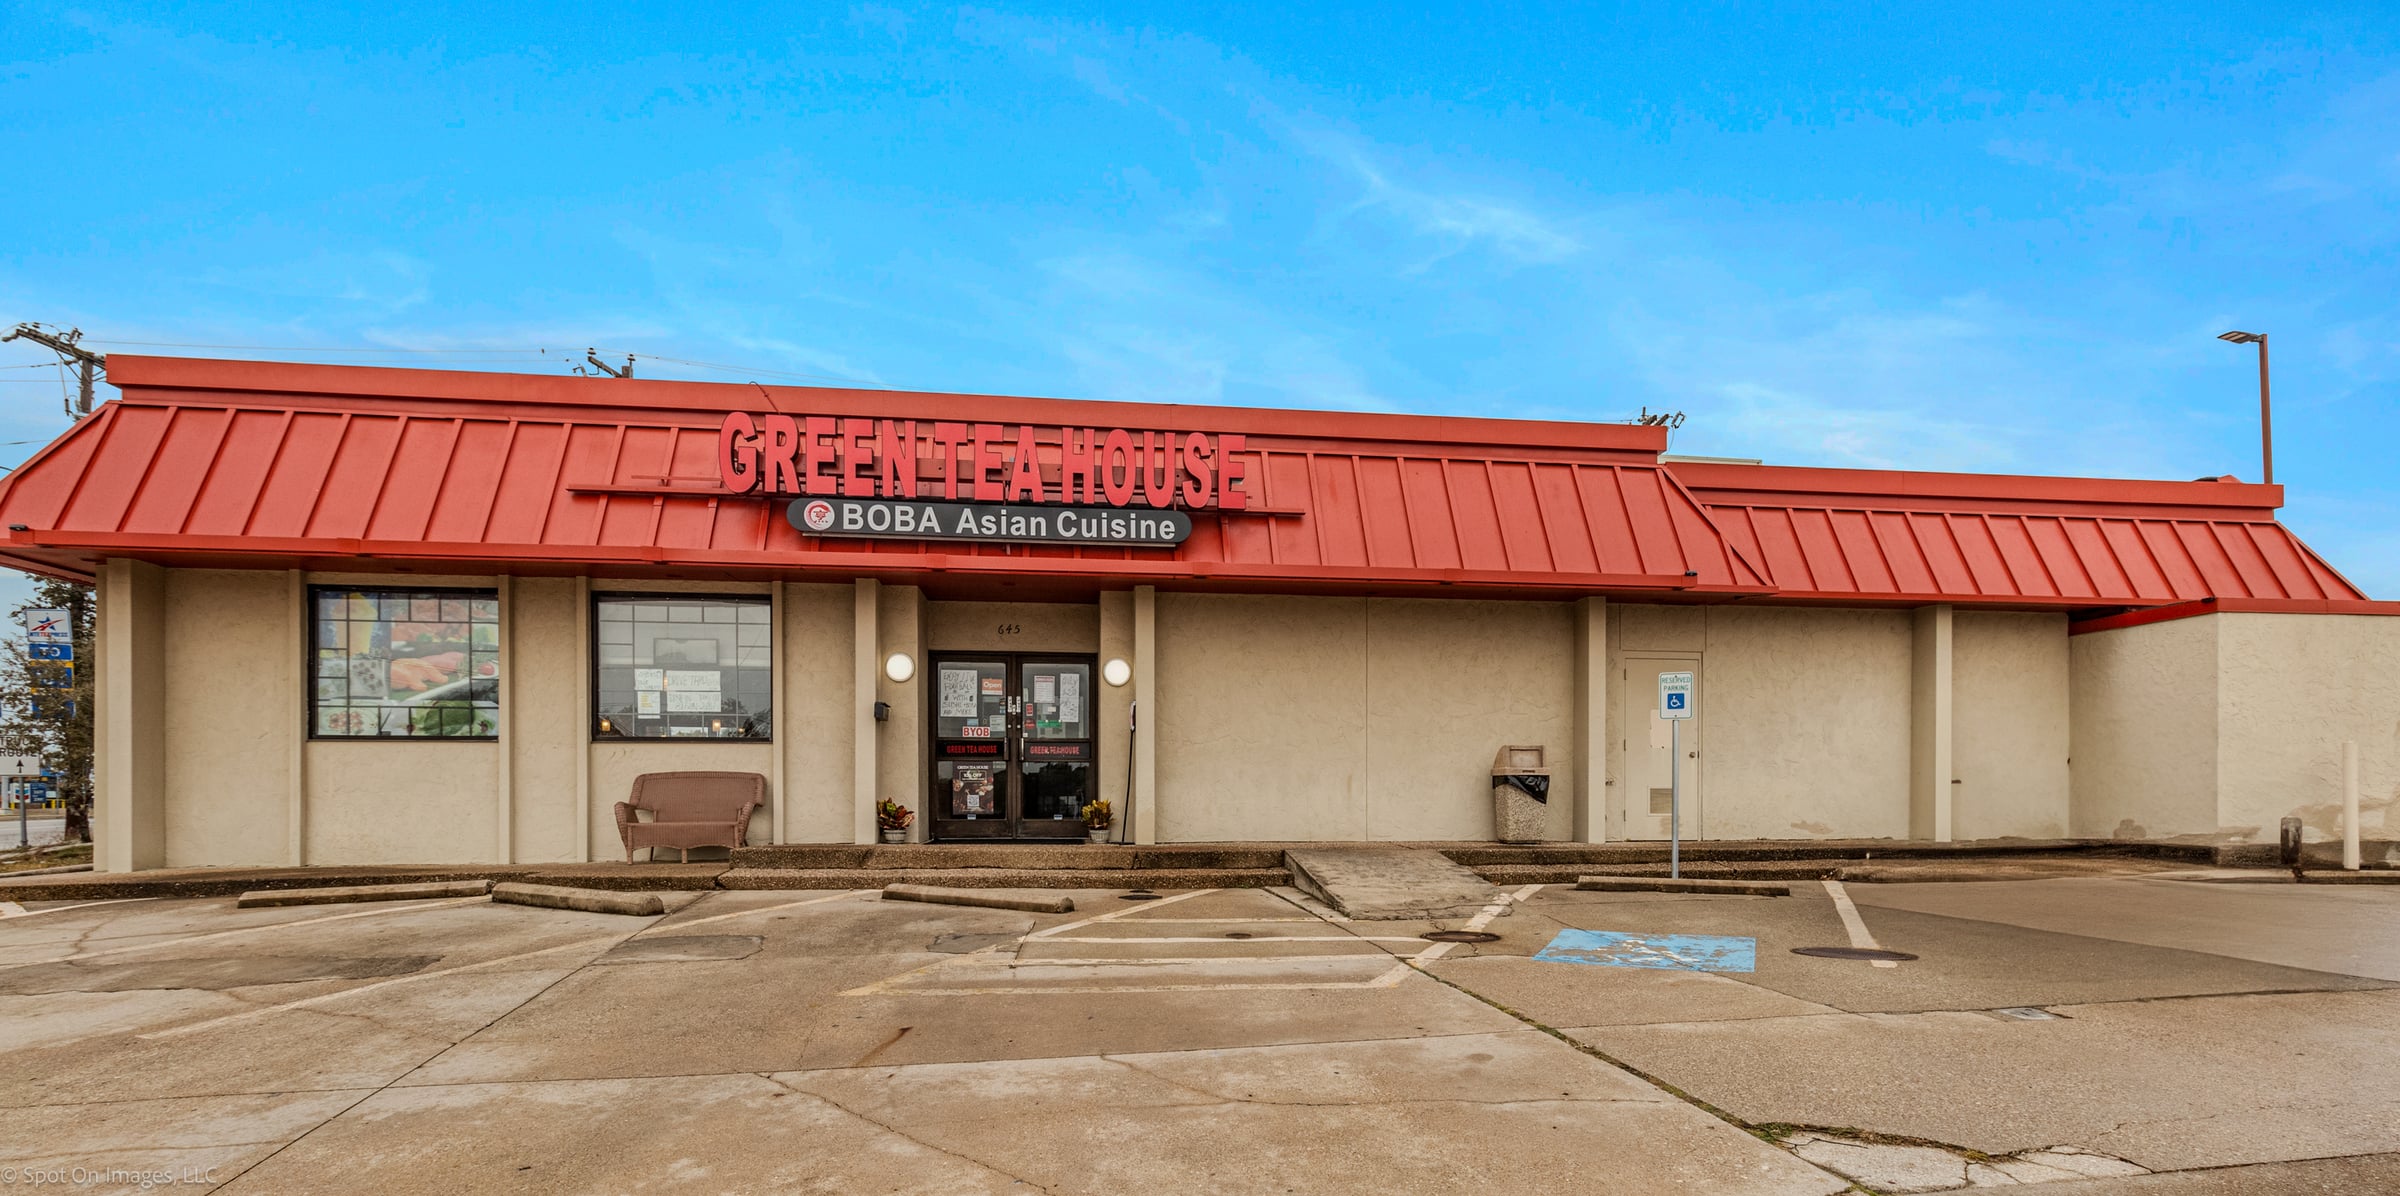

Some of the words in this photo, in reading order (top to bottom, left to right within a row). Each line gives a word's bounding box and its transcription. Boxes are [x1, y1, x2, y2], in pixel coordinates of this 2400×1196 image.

[719, 411, 917, 498] GREEN
[934, 422, 1045, 503] TEA
[1062, 428, 1247, 509] HOUSE
[843, 503, 942, 533] BOBA
[956, 507, 1047, 537] Asian
[1057, 510, 1176, 540] Cuisine
[998, 624, 1020, 634] 645
[963, 727, 990, 737] BYOB
[947, 745, 965, 753] GREEN
[967, 745, 977, 753] TEA
[978, 745, 997, 753] HOUSE
[1030, 745, 1049, 754] GREEN
